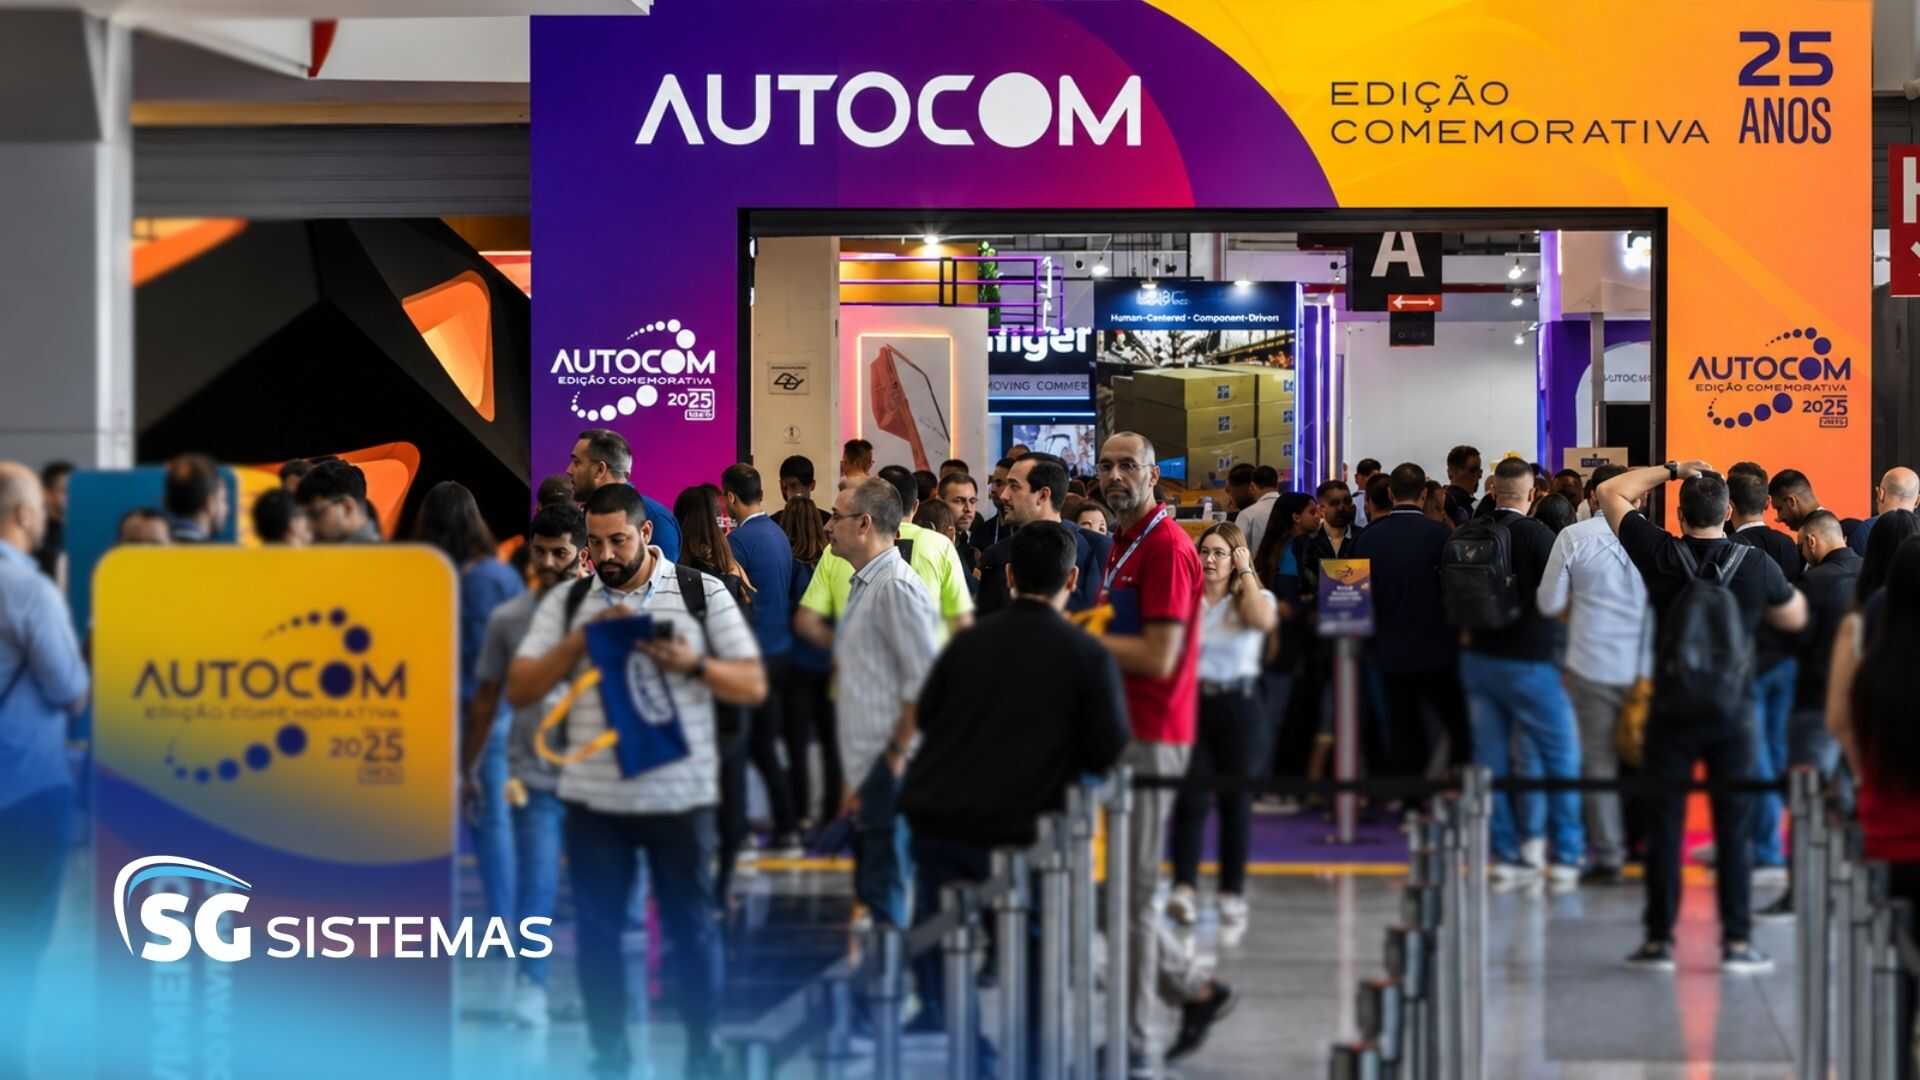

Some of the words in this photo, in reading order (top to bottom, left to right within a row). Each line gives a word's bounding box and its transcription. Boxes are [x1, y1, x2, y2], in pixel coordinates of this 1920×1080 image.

[1738, 31, 1834, 87] 25
[1331, 74, 1509, 112] EDIÇÃO
[635, 71, 1142, 148] AUTOCOM
[1738, 97, 1832, 145] ANOS
[1331, 119, 1709, 145] COMEMORATIVA
[1371, 231, 1425, 277] A
[1110, 313, 1186, 323] Human-Centered
[550, 348, 716, 375] AUTOCOM
[1688, 356, 1851, 381] AUTOCOM
[557, 374, 605, 386] EDIÇÃO
[609, 376, 712, 386] COMEMORATIVA
[1695, 382, 1742, 394] EDIÇÃO
[1746, 383, 1847, 392] COMEMORATIVA
[667, 392, 713, 409] 2025
[1802, 399, 1848, 416] 2025
[133, 660, 407, 699] AUTOCOM
[330, 731, 405, 763] 2025
